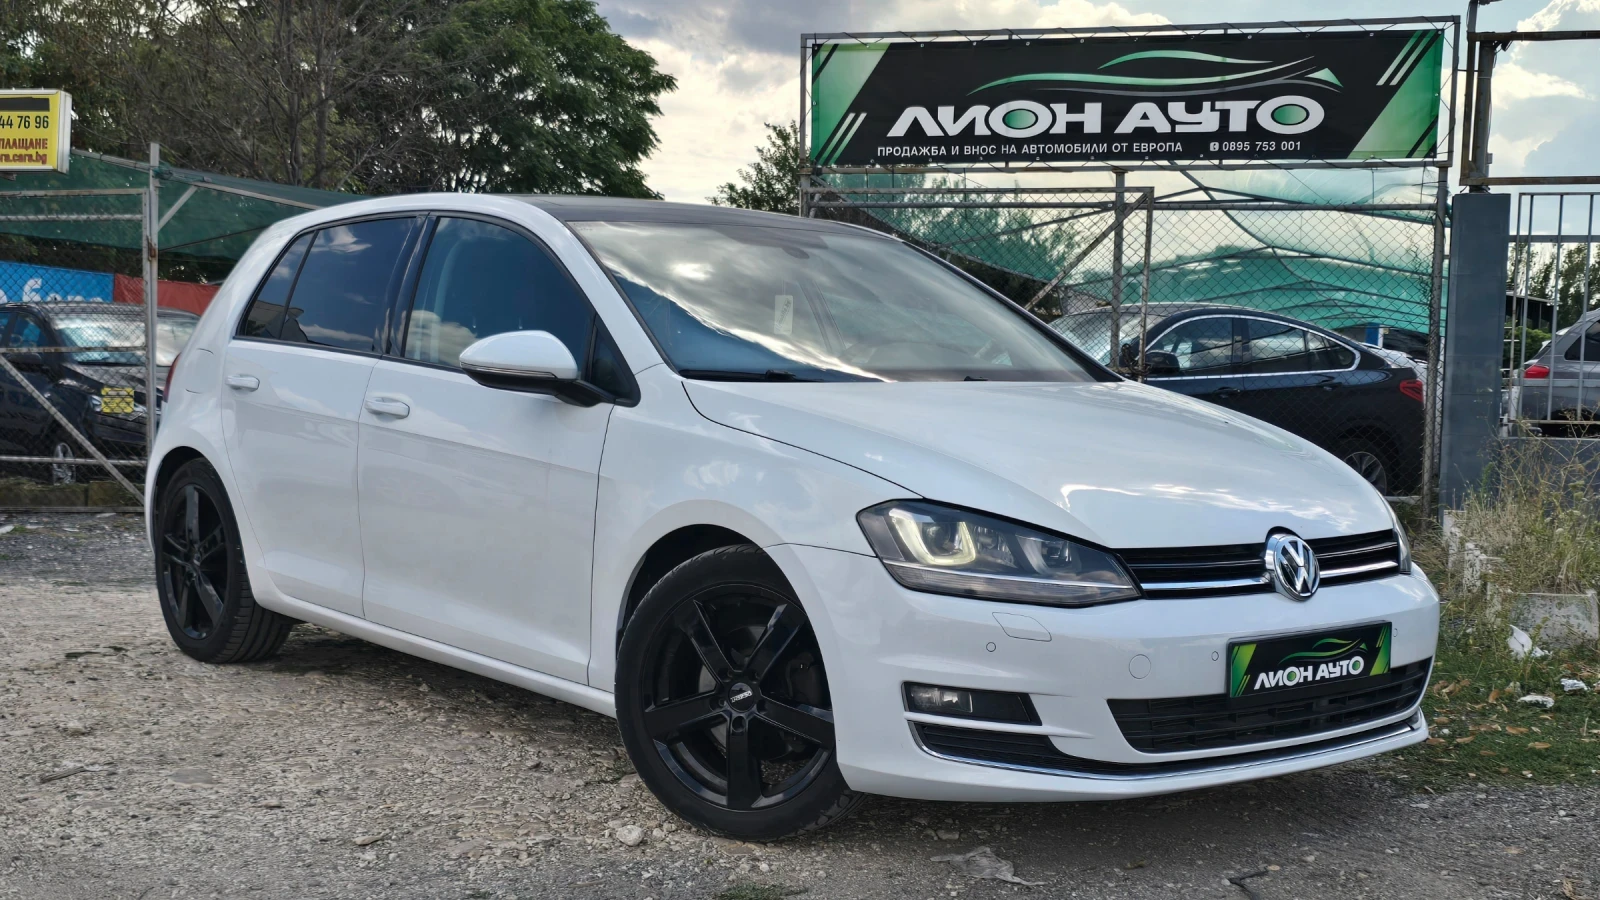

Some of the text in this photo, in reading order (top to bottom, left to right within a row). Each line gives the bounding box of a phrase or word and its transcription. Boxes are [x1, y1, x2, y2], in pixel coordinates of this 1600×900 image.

[17, 116, 31, 129] 76
[35, 116, 49, 129] 96
[886, 95, 1325, 138] ЛИОН АУТО
[0, 138, 48, 151] ПЛАЩАНЕ
[877, 142, 1183, 157] ПРОДАЖБА И ВНОС НА АВТОМОБИЛИ ОТ ЕВРОПА
[1222, 141, 1301, 151] 0895 753 001
[1254, 656, 1365, 690] ЛИОН АУТО
